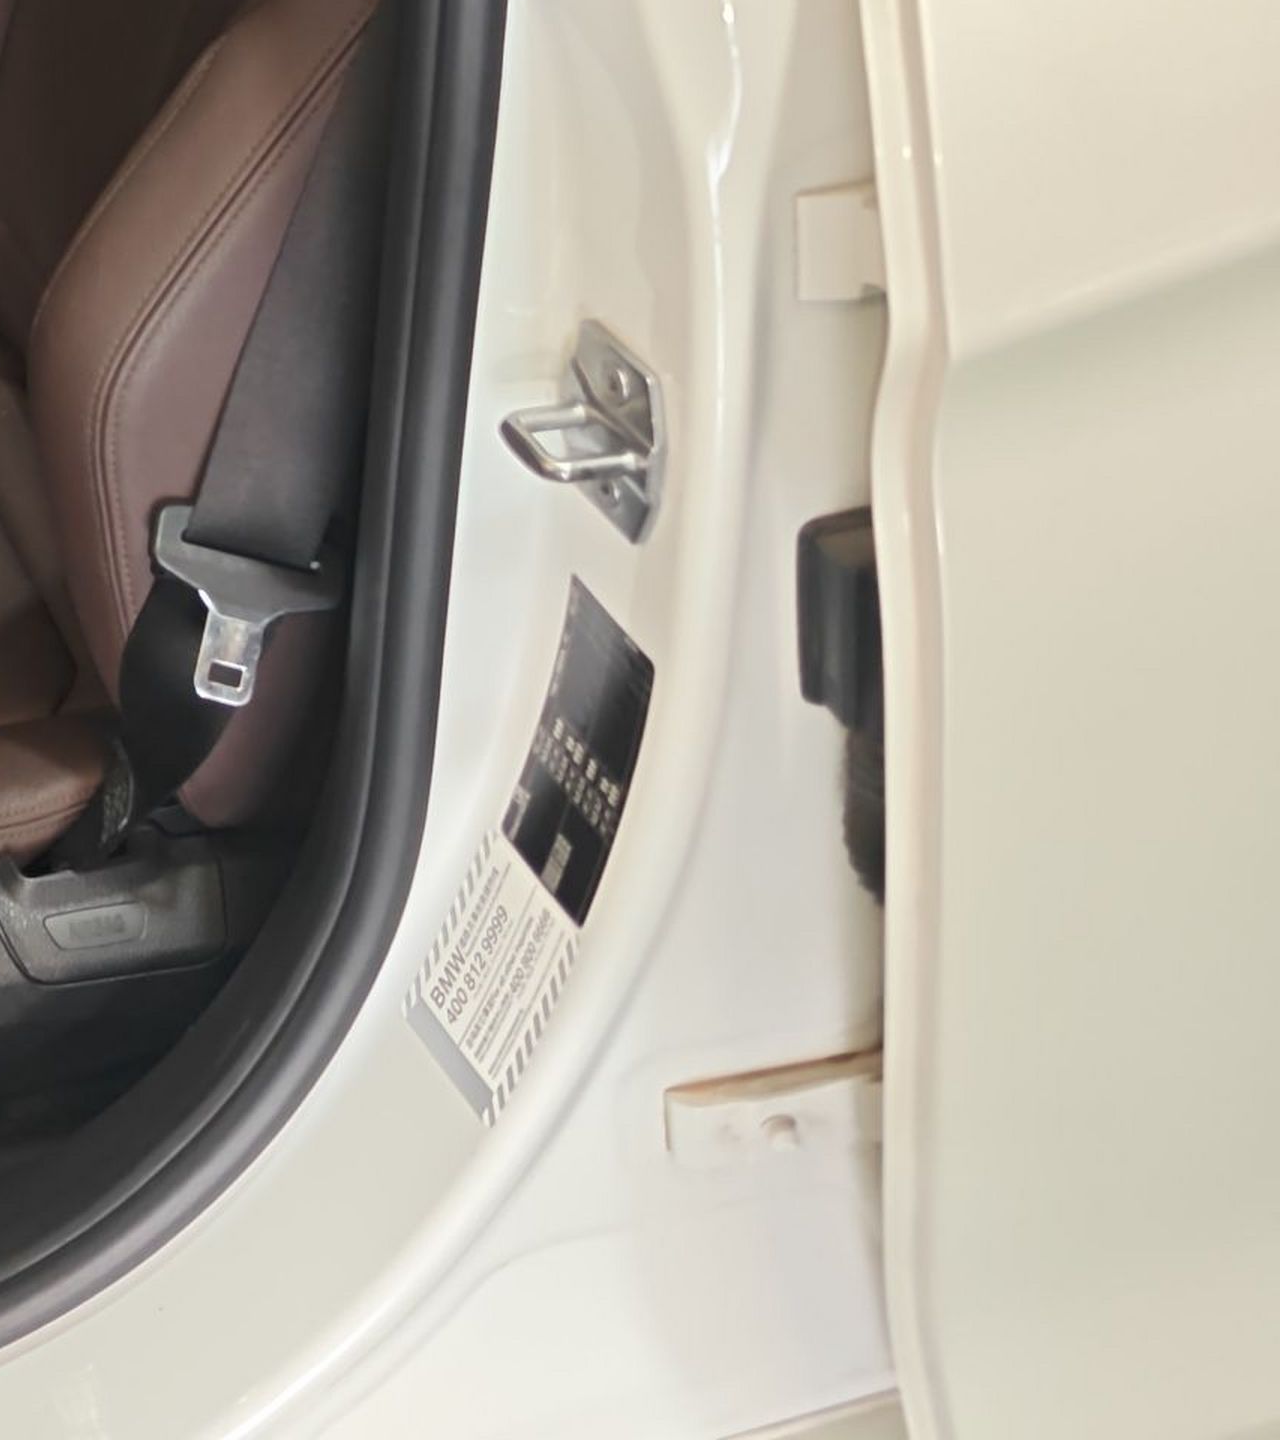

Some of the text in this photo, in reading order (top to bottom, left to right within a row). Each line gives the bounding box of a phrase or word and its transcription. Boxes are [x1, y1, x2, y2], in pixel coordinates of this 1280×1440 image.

[430, 945, 466, 1009] BMW
[445, 987, 468, 1024] 400
[463, 952, 486, 992] 812
[481, 905, 508, 955] 9999
